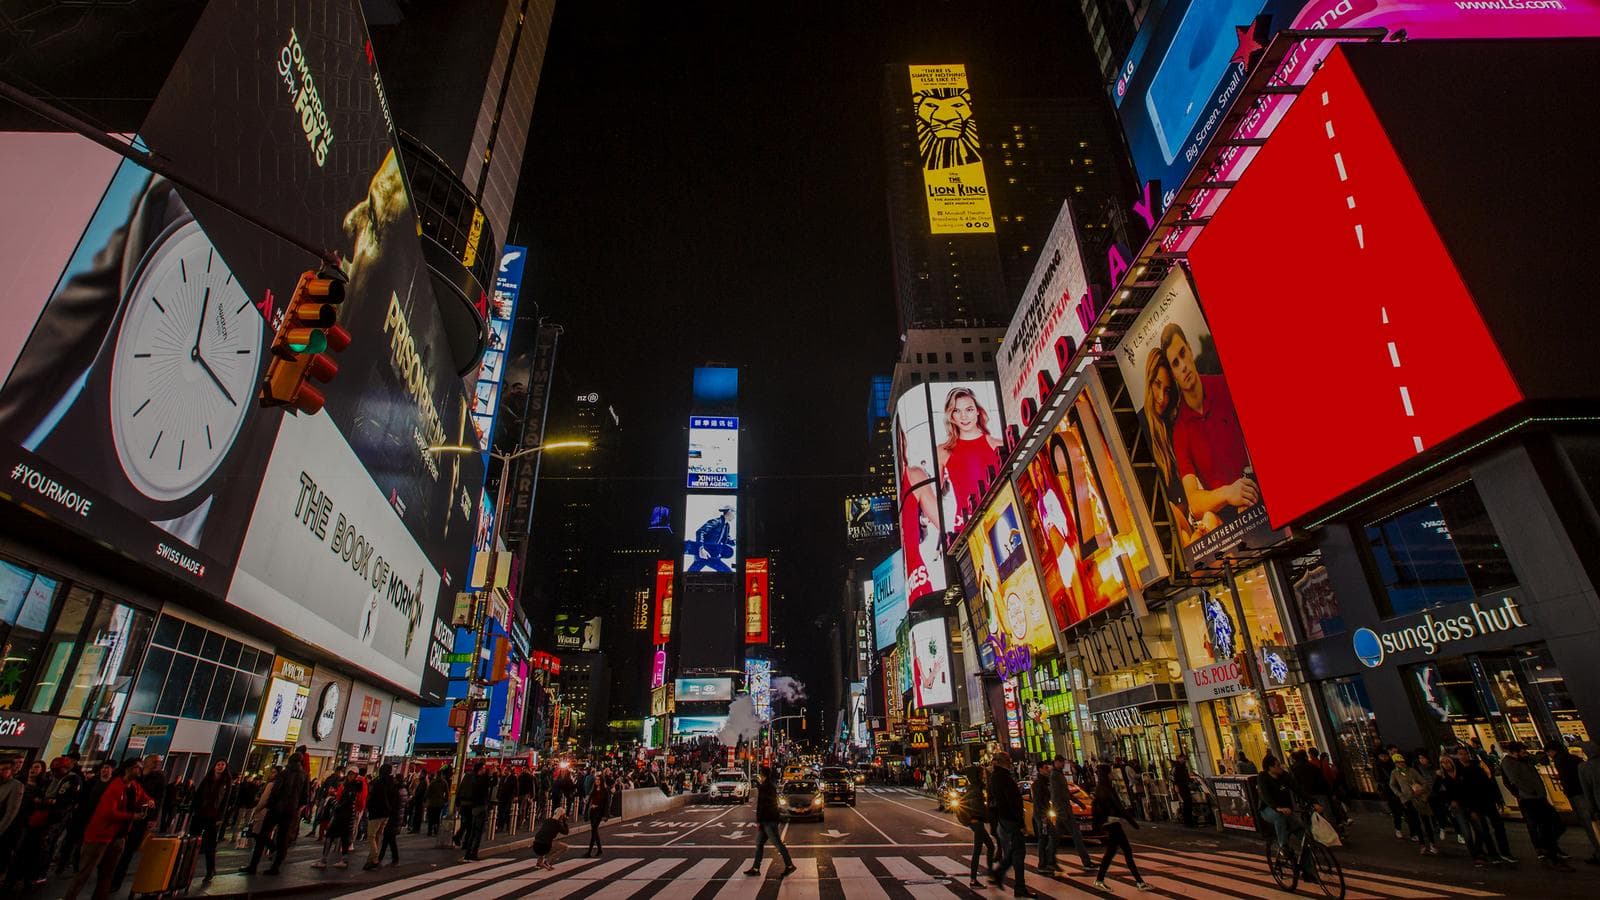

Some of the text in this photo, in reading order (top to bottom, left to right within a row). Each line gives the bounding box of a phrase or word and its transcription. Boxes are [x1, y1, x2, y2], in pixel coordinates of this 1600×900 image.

[289, 27, 334, 145] TOMORROW
[1123, 60, 1135, 82] LG
[295, 87, 328, 167] FOX 5
[374, 72, 392, 133] MARRIOTT
[1185, 145, 1199, 162] Big
[1218, 74, 1240, 109] Small
[928, 183, 987, 197] LION KING
[1007, 350, 1013, 366] A
[1011, 249, 1062, 357] HEARTWARMING
[1021, 322, 1038, 354] BOOK
[1037, 298, 1047, 323] BY
[1143, 311, 1160, 336] POLO
[1012, 356, 1035, 401] HARVEY
[515, 345, 551, 509] TIMES SQUARE
[10, 463, 93, 517] #YOURMOVE
[295, 471, 333, 541] THE
[331, 512, 374, 581] BOOK
[371, 556, 390, 592] OF
[848, 523, 894, 535] PHANTOM
[1191, 540, 1206, 554] LIVE
[1207, 504, 1267, 545] AUTHENTICALLY
[156, 542, 200, 575] SWISS MADE
[639, 587, 650, 629] NOVOTEL
[1381, 597, 1528, 655] sunglass hut
[1075, 612, 1153, 687] FOREVER
[1193, 663, 1239, 686] U.S. POLO
[1213, 684, 1235, 695] SINCE
[1102, 709, 1135, 730] FOREVER
